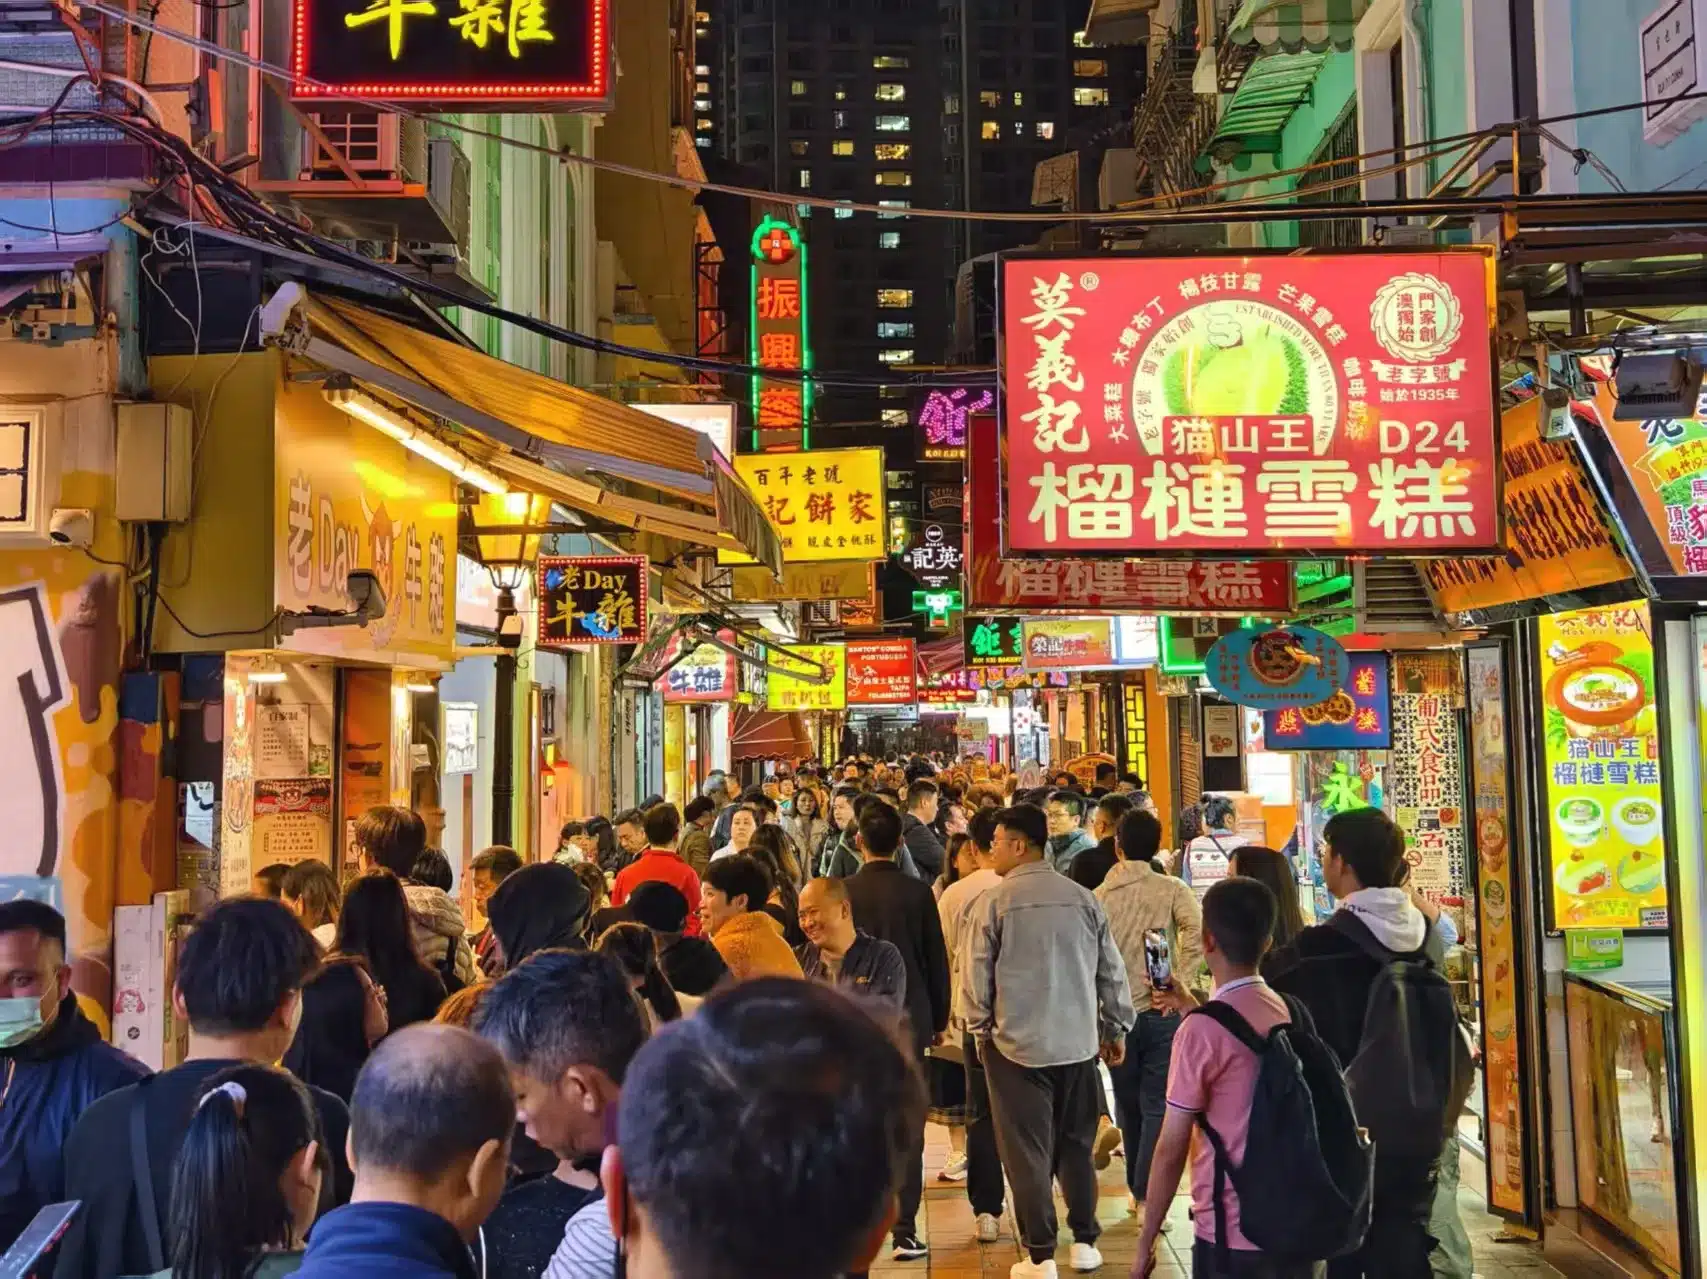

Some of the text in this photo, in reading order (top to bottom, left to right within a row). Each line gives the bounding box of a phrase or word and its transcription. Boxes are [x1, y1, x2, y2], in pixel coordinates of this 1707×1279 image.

[1236, 303, 1303, 337] ESTABLISHED
[1301, 335, 1322, 361] MORE
[1020, 272, 1090, 453] 莫義記
[1386, 366, 1450, 382] 老字號
[1379, 420, 1470, 453] D24
[754, 466, 843, 486] 百年老號
[1028, 458, 1477, 542] 榴槤雪糕
[558, 564, 627, 593] 老Day
[546, 590, 638, 636] 牛雜
